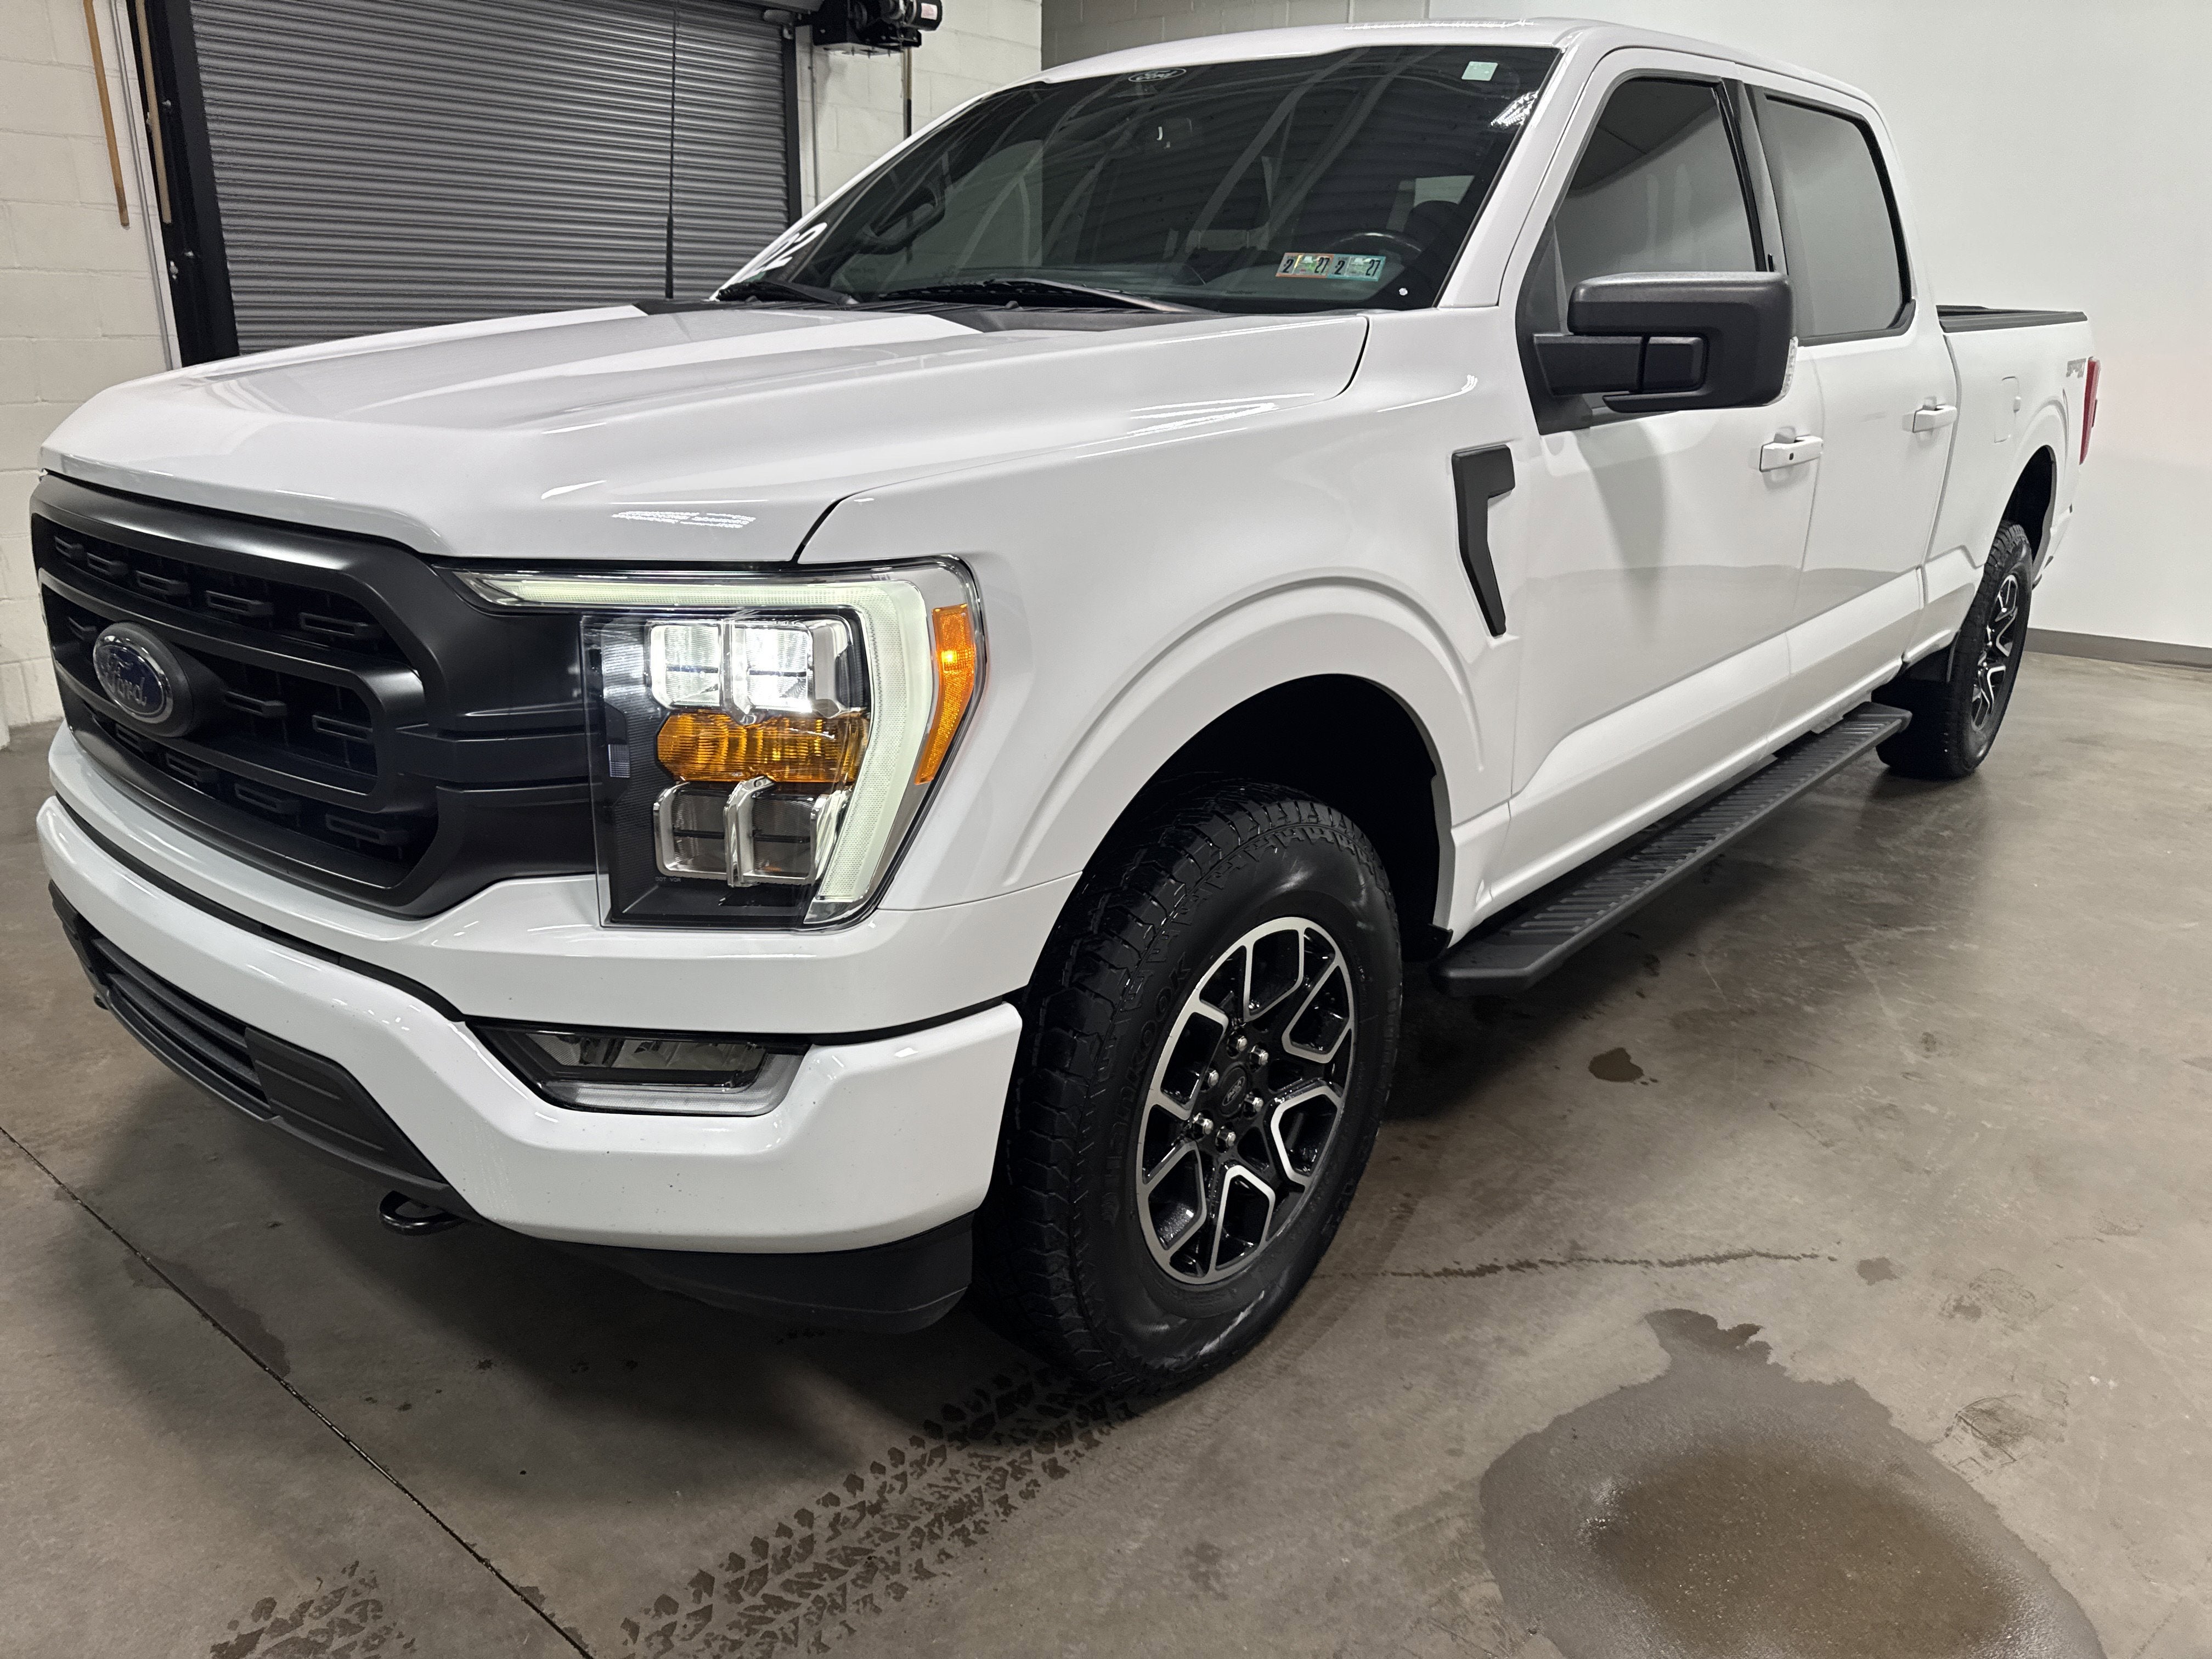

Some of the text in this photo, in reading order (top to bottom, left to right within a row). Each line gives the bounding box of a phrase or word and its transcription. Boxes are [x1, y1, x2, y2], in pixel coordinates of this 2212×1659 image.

[1283, 257, 1330, 274] 2 27
[1334, 259, 1381, 276] 2 27
